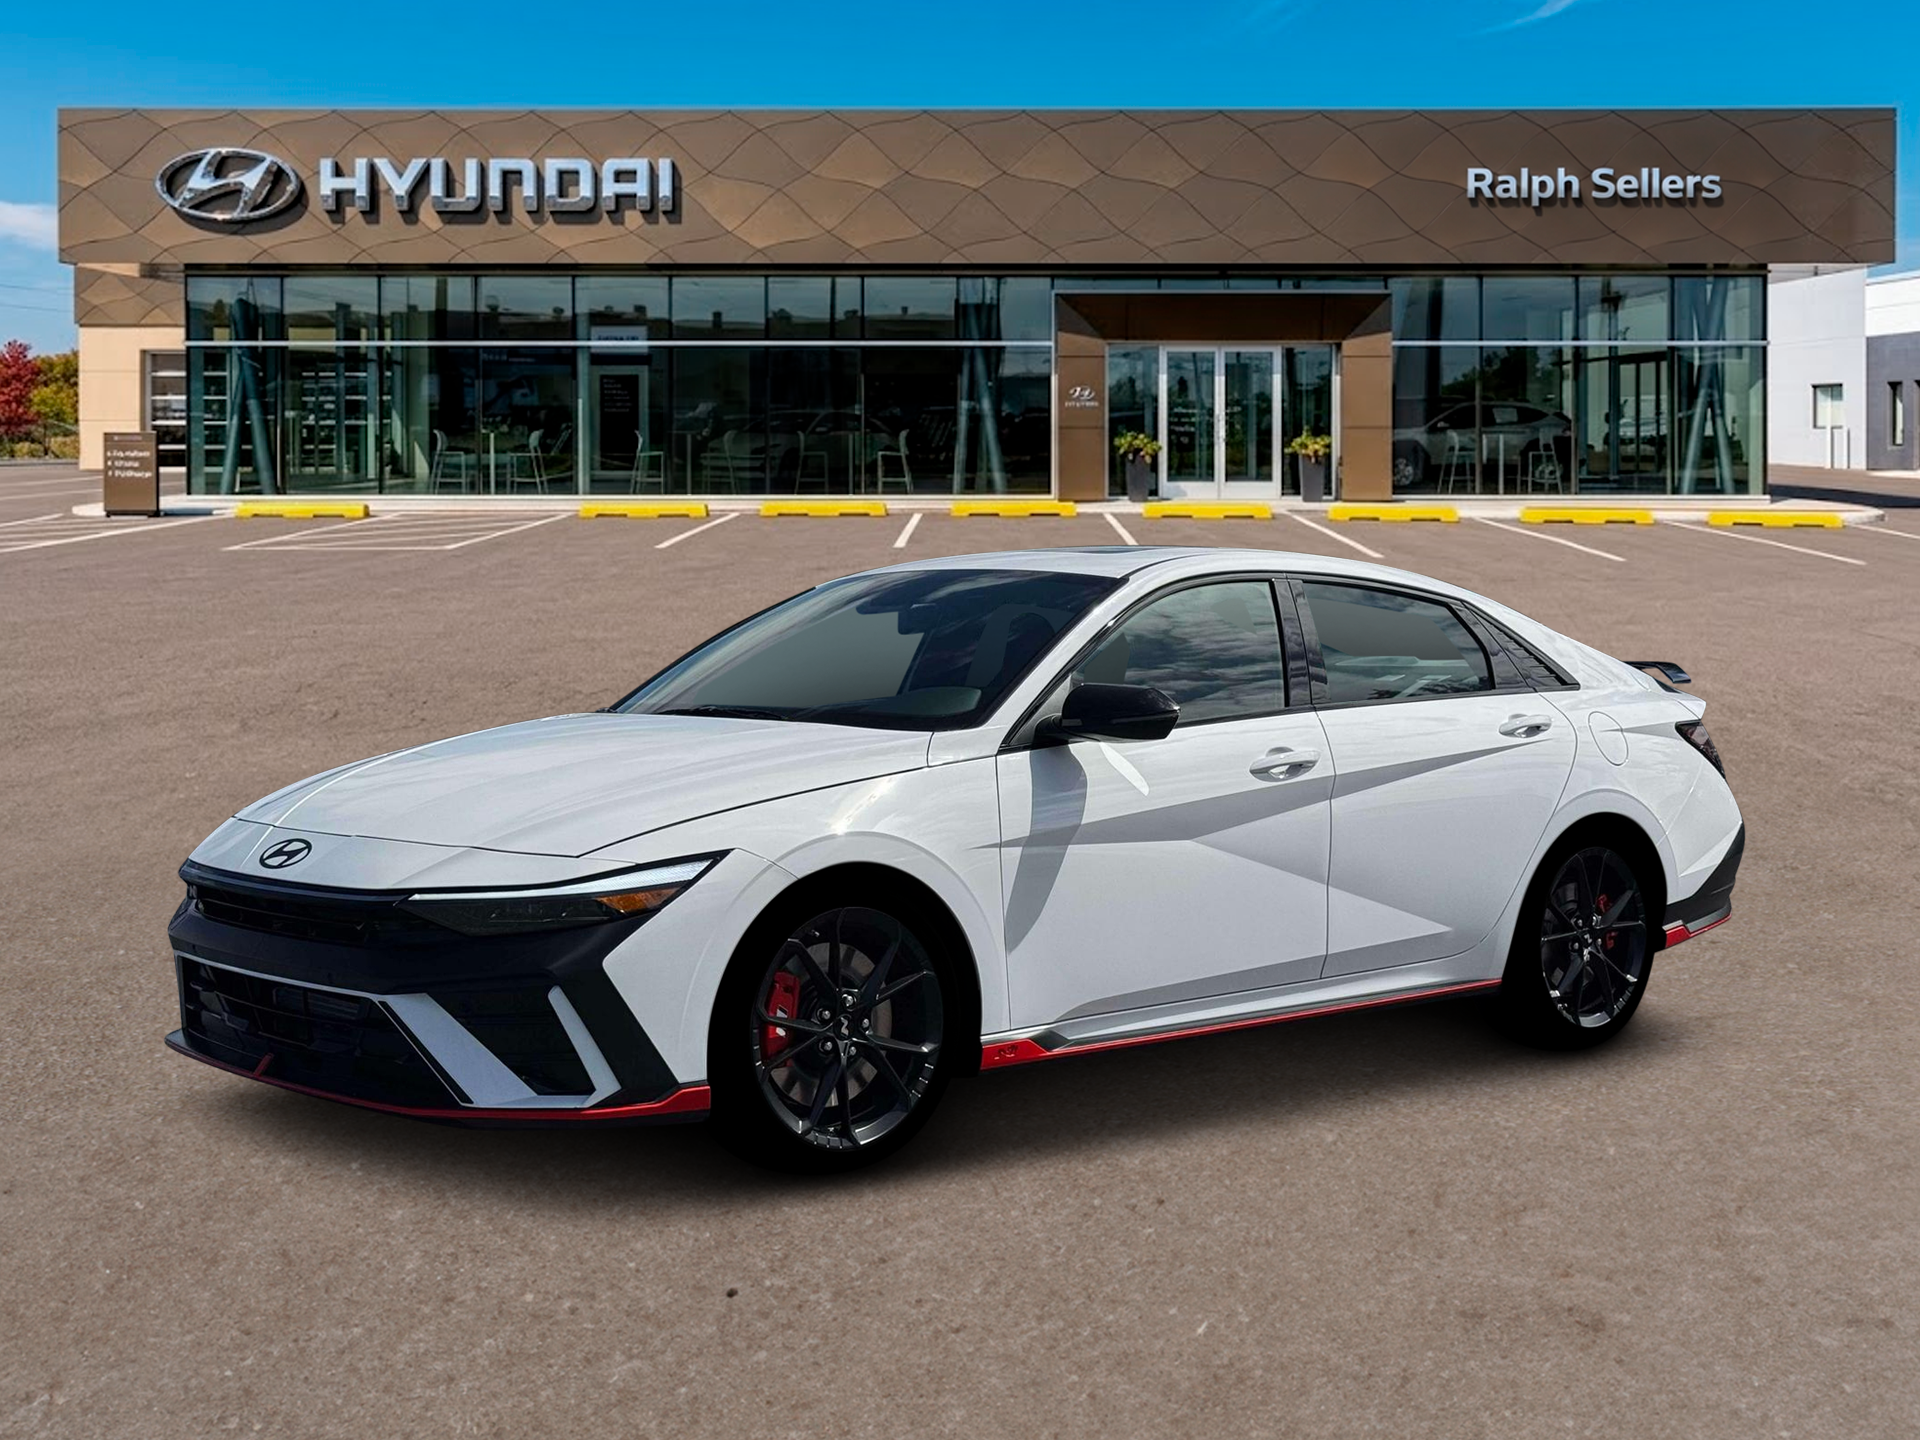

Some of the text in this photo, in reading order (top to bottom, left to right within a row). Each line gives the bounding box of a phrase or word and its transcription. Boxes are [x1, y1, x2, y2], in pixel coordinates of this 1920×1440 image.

[319, 157, 673, 212] HYUNDAI
[1467, 167, 1722, 207] Ralph Sellers
